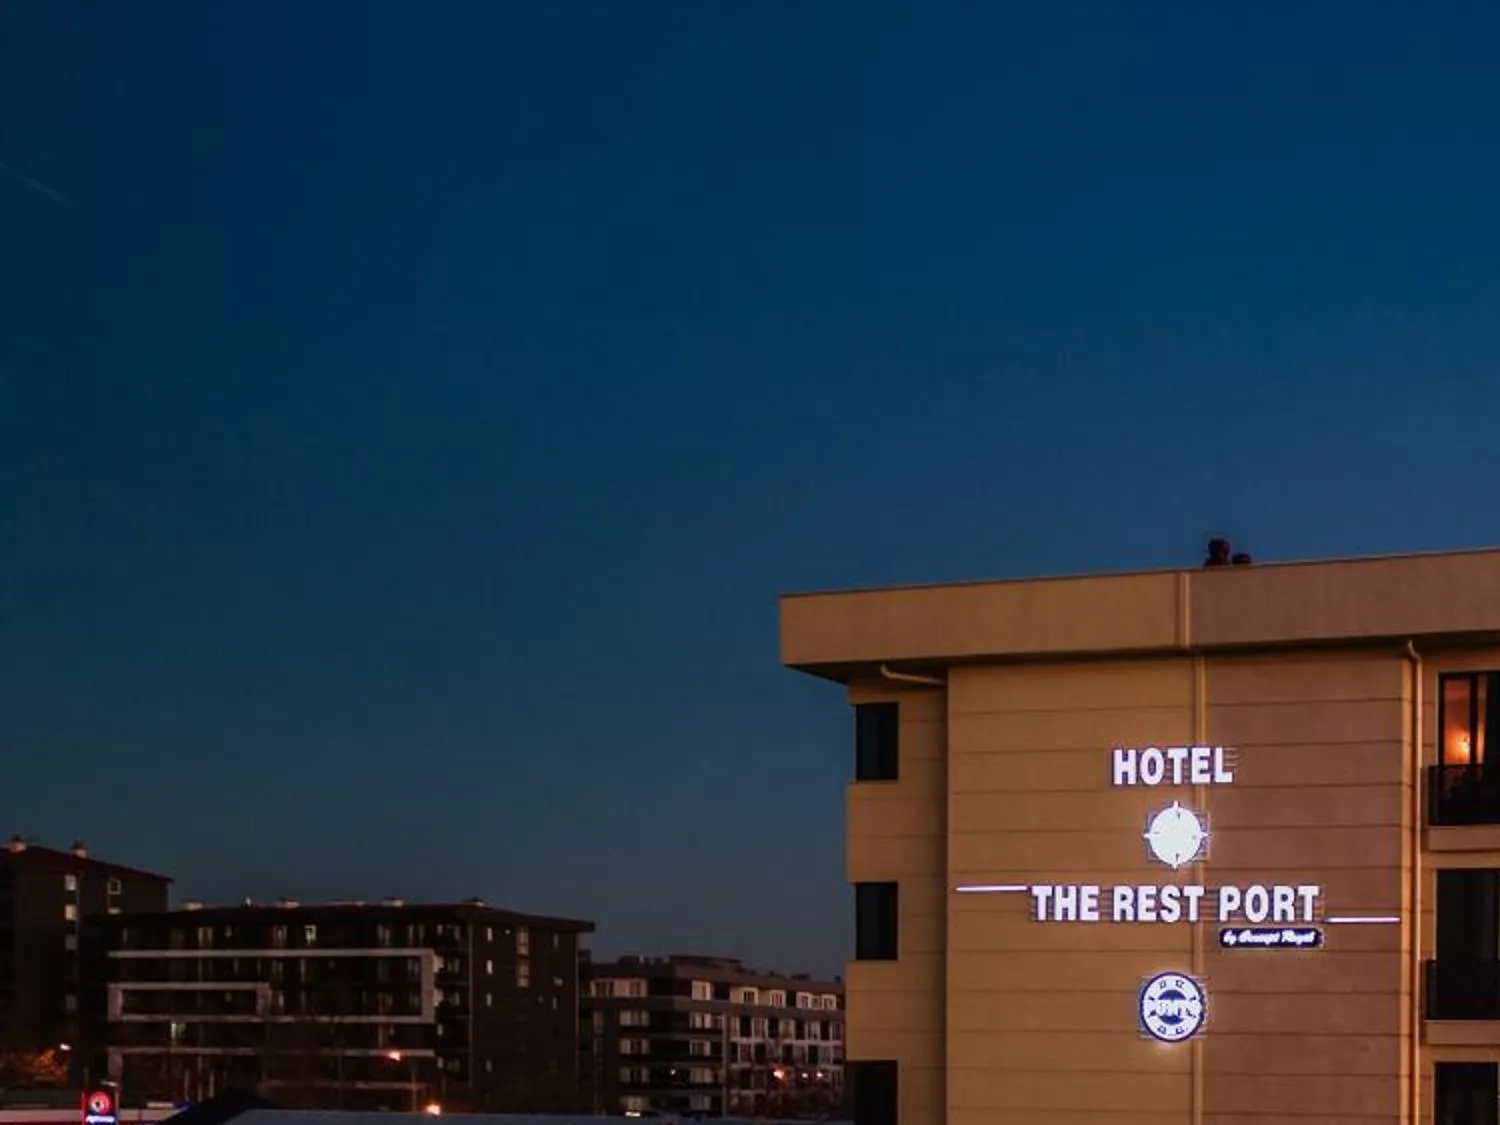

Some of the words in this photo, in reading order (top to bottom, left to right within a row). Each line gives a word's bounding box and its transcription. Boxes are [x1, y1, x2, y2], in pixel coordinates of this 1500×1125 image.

[1113, 747, 1233, 785] HOTEL
[1031, 885, 1100, 921] THE
[1113, 885, 1205, 923] REST
[1219, 885, 1320, 923] PORT
